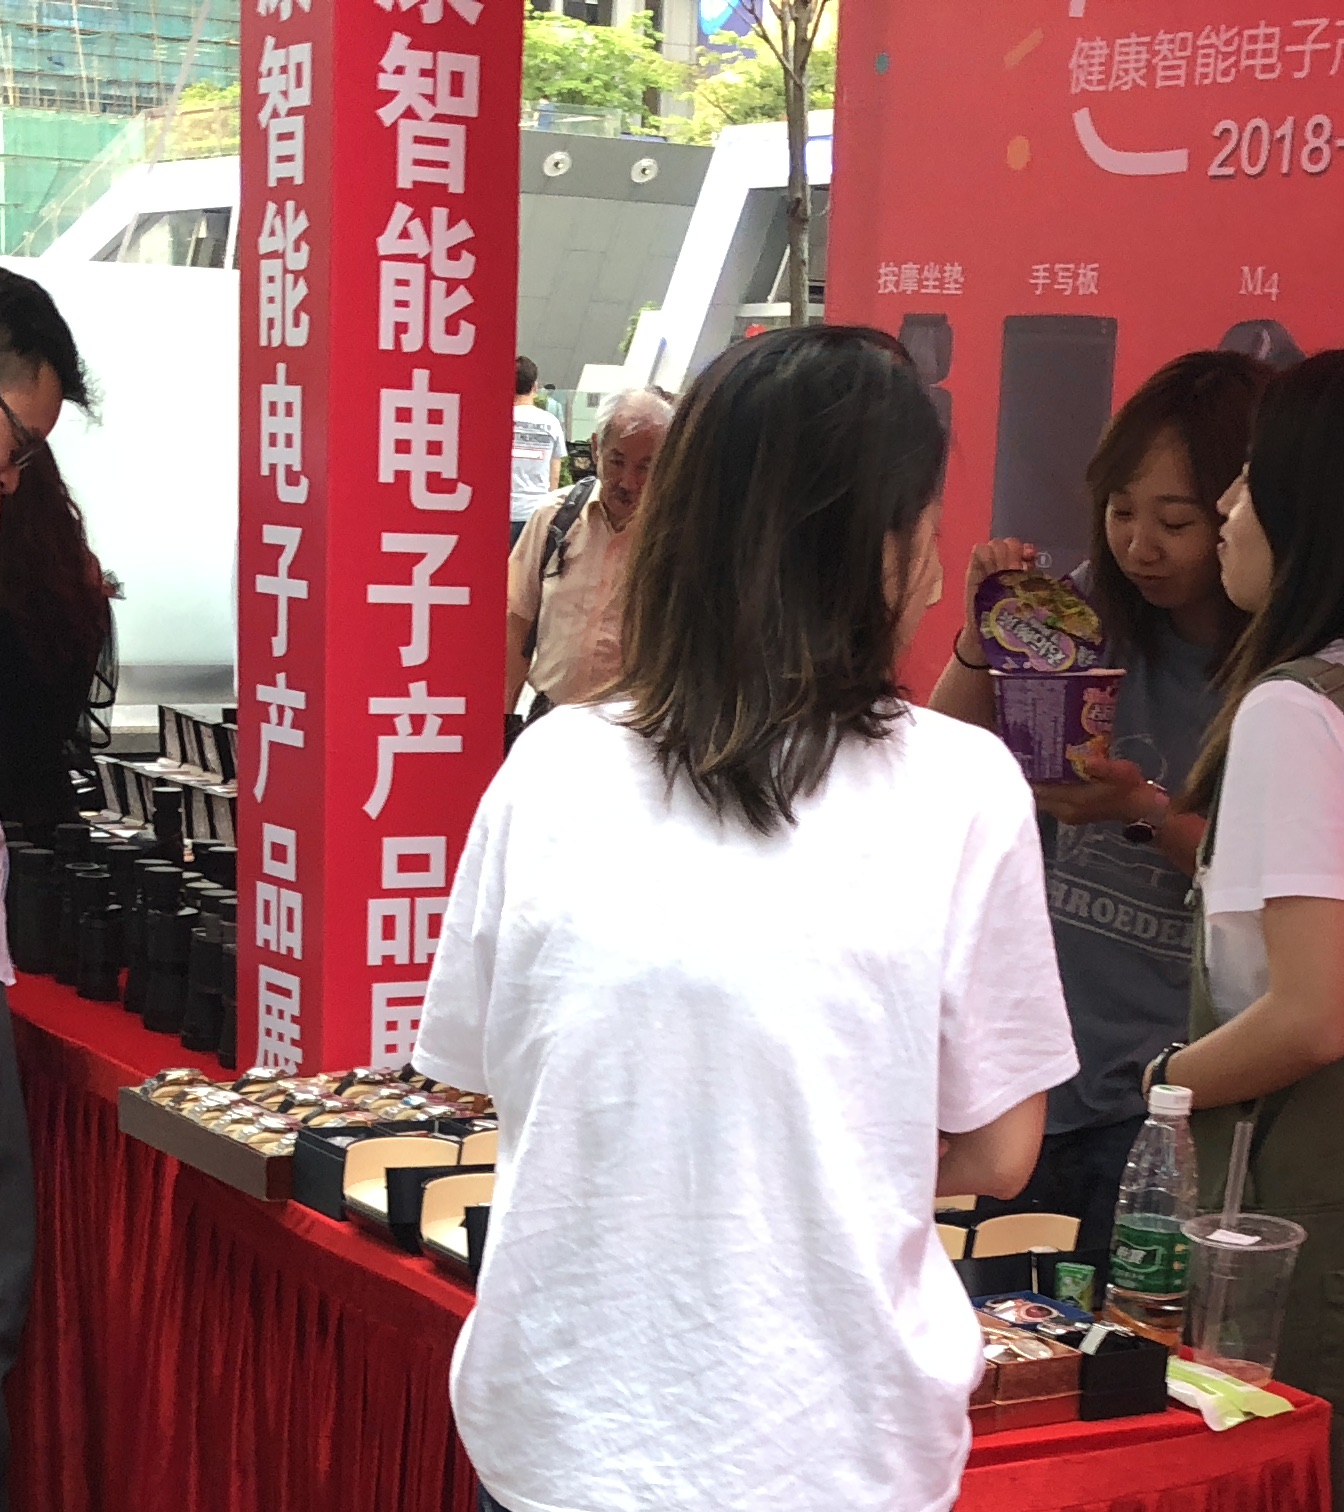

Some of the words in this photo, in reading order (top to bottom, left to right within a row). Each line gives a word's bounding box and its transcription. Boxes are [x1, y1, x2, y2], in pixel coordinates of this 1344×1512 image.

[877, 262, 965, 297] 按摩坐垫
[1028, 262, 1100, 297] 手写板
[1239, 266, 1281, 301] M4
[253, 0, 312, 1074] 智能电子产品展
[362, 0, 484, 1069] 智能电子产品
